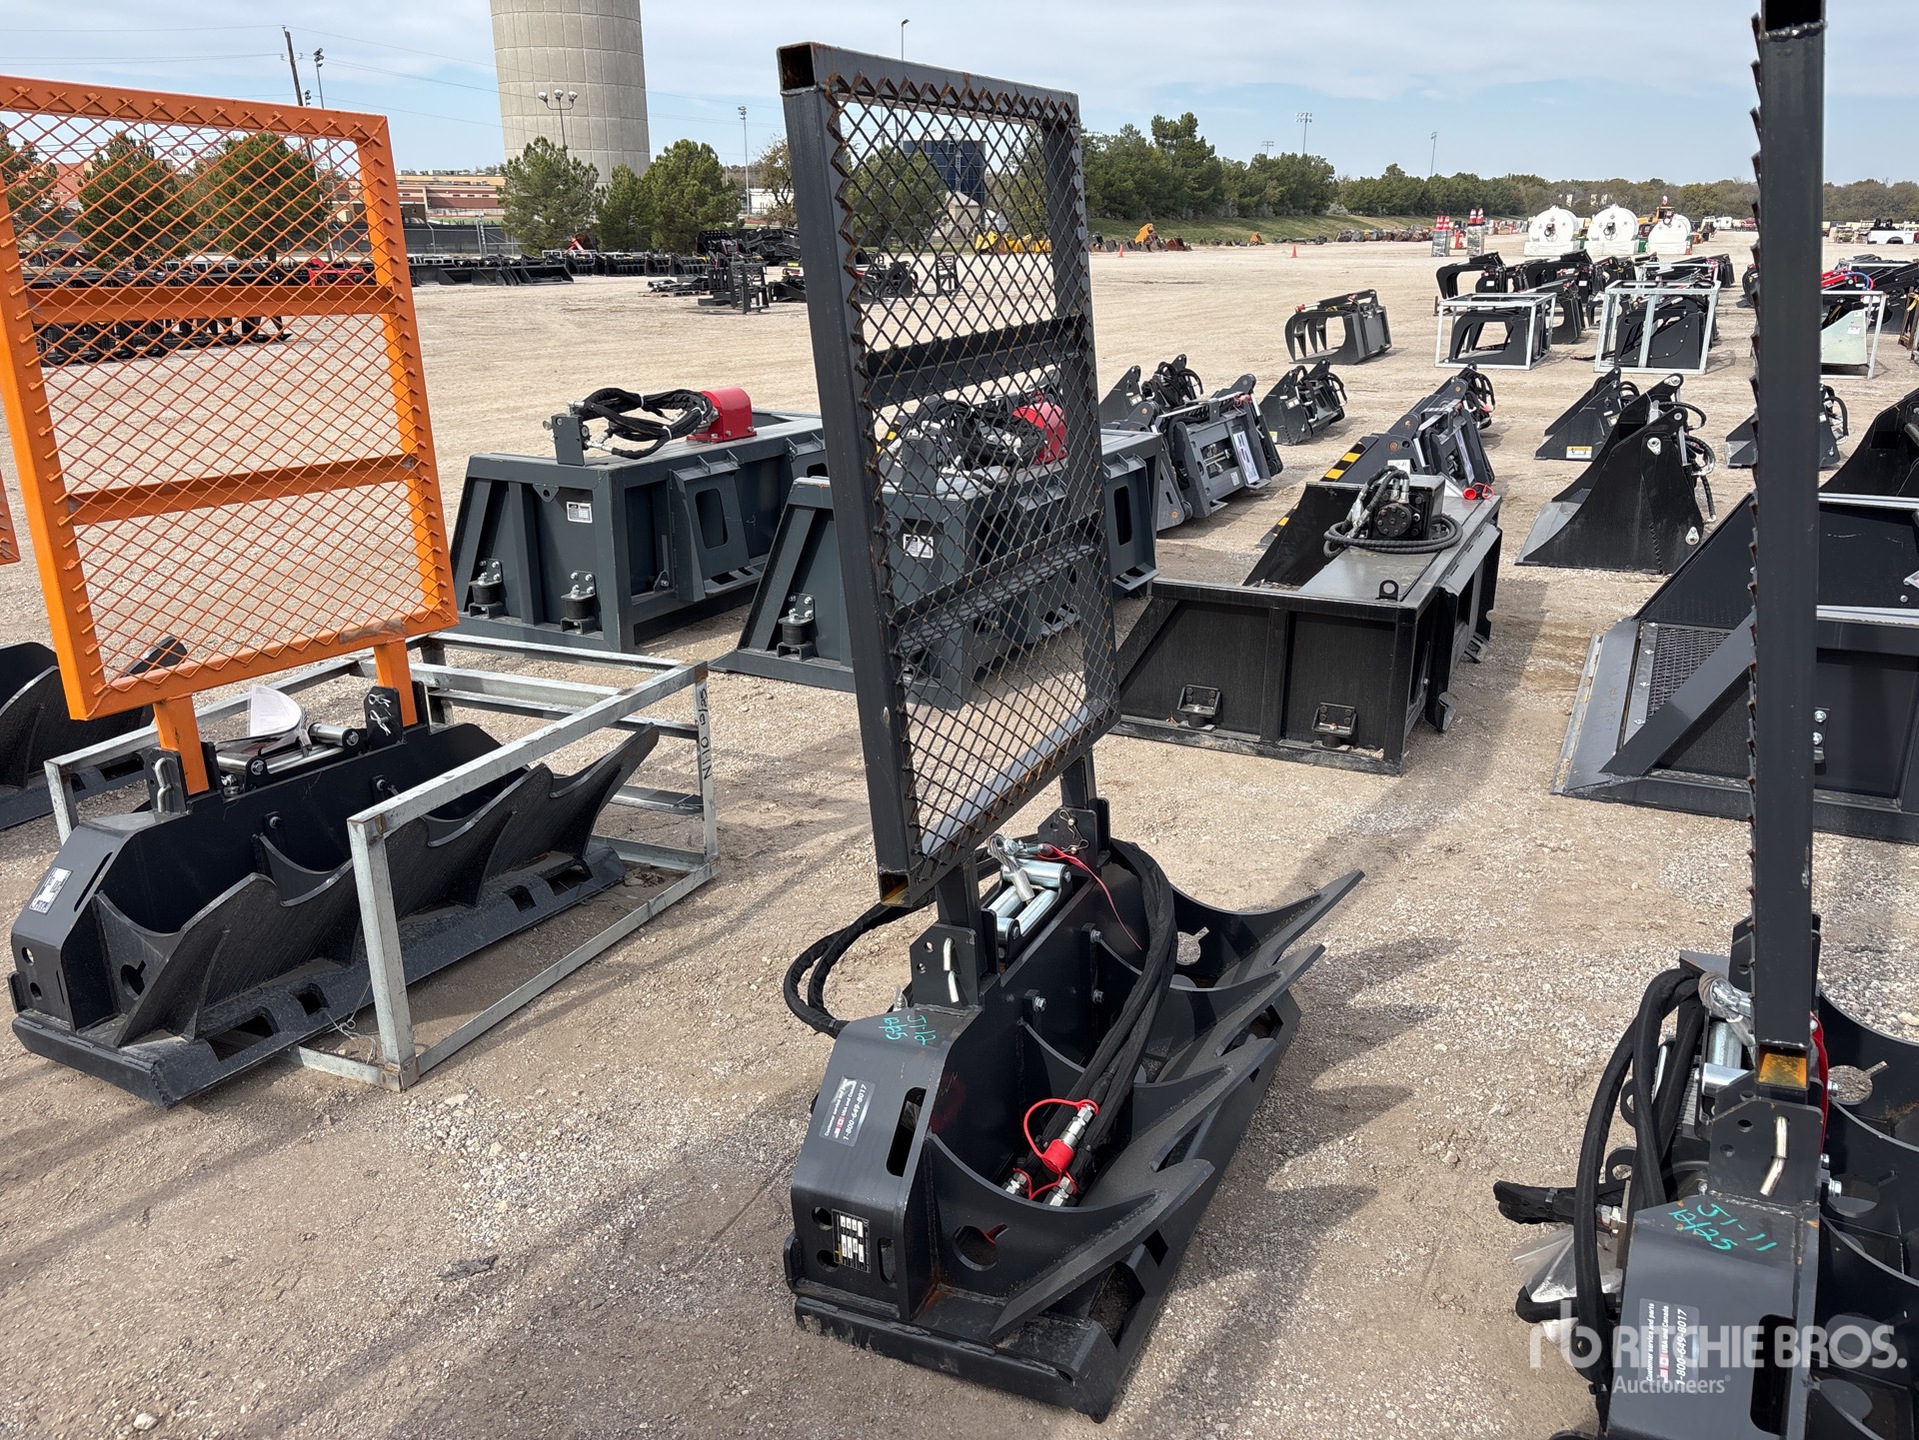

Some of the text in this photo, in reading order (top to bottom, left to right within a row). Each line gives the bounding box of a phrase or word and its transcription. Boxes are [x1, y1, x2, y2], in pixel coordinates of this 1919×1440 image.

[840, 1106, 848, 1117] USA
[842, 1083, 868, 1141] 1-800-649-8017
[1646, 1318, 1655, 1330] and
[1648, 1303, 1656, 1319] parts
[1661, 1305, 1669, 1354] USA and Canada
[1675, 1309, 1688, 1386] 1-800-649-8017
[1645, 1353, 1654, 1382] Customer
